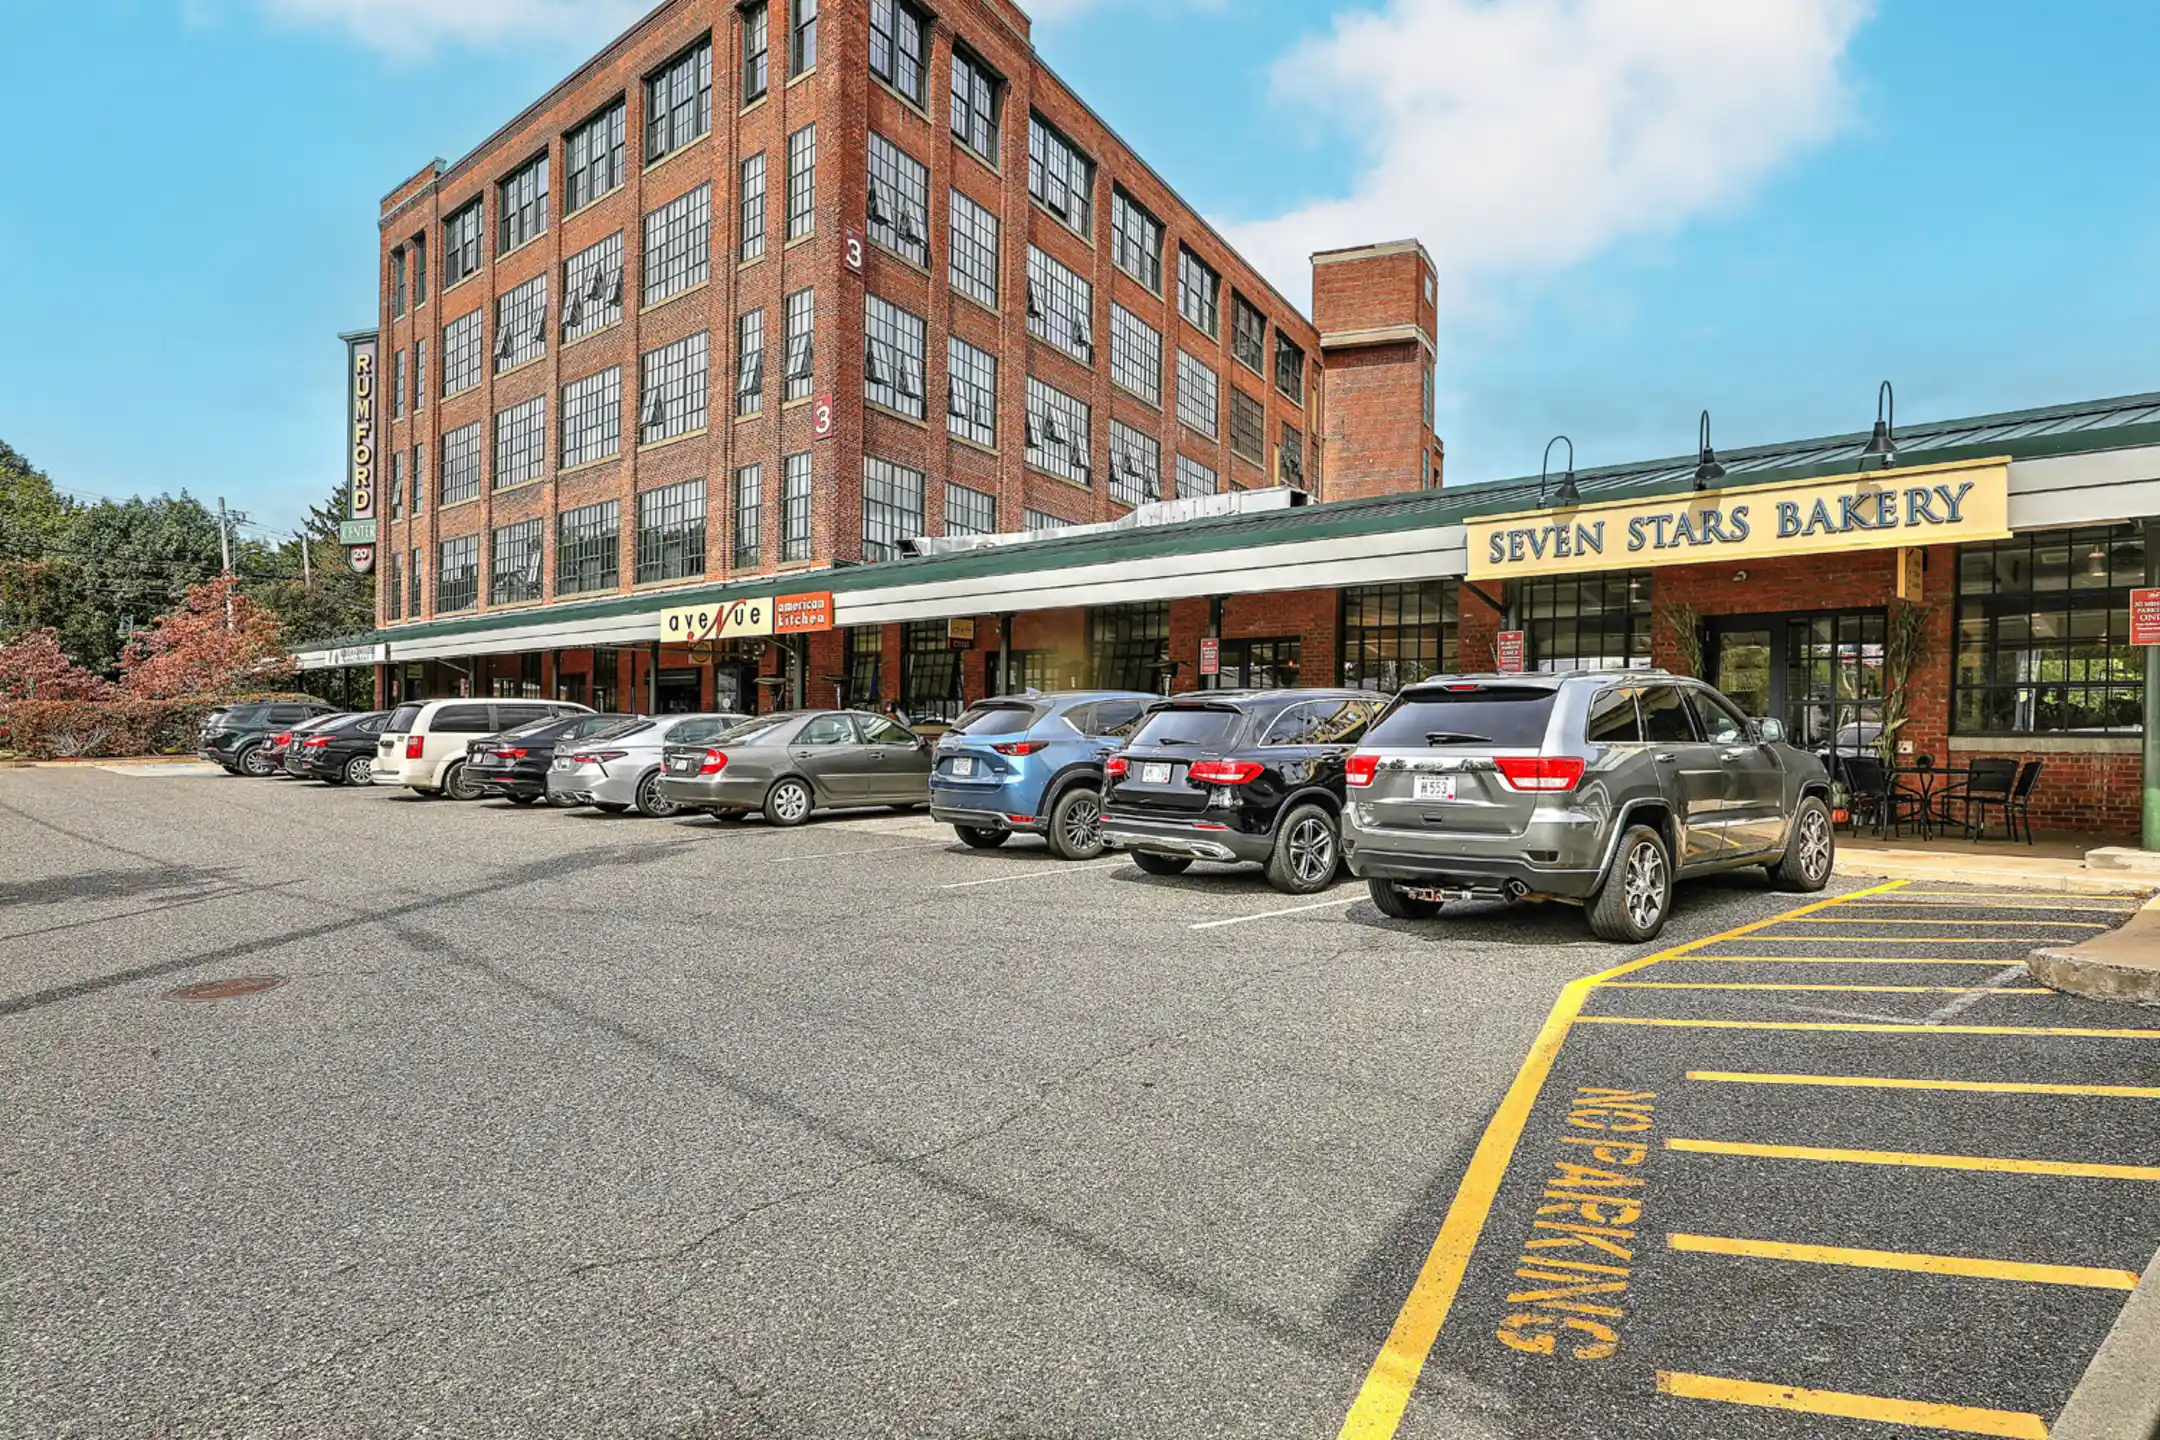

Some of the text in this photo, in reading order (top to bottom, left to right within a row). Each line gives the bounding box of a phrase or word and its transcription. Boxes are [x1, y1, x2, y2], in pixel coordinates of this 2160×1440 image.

[846, 238, 862, 268] 3
[353, 353, 373, 512] RUMFORD
[815, 405, 831, 434] 3
[342, 524, 376, 540] CENTER
[1488, 481, 1976, 563] SEVEN STARS BAKERY
[353, 548, 370, 561] 20
[778, 596, 825, 613] american
[778, 611, 825, 627] kitchen
[1566, 1086, 1657, 1132] NO
[1496, 1136, 1649, 1359] PARKING
